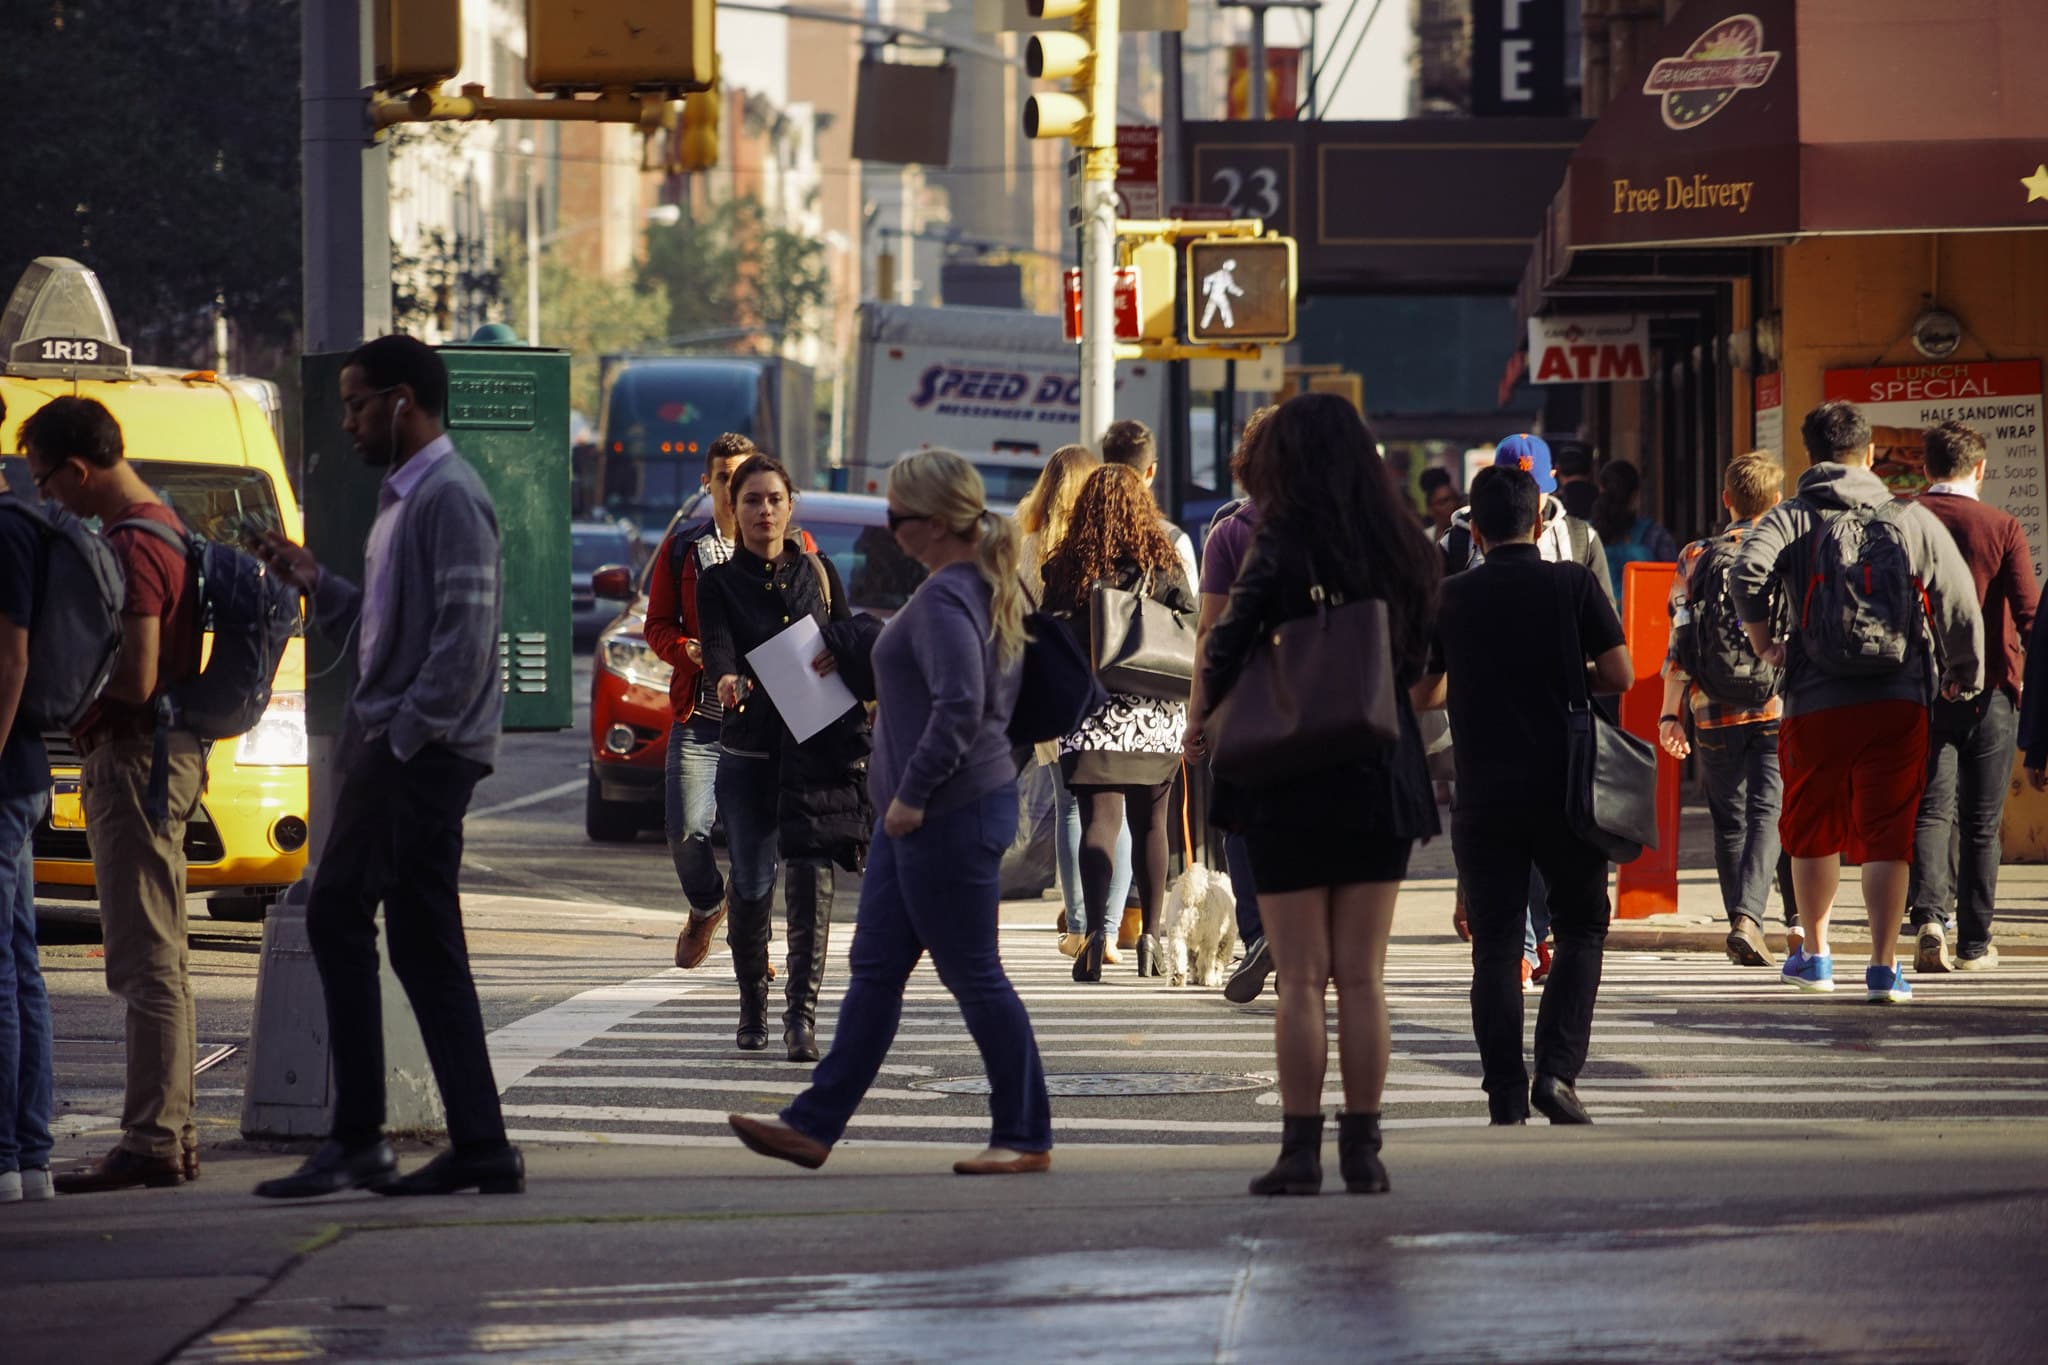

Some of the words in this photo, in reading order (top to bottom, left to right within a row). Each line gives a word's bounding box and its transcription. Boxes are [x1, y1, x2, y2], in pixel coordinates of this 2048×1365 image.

[1211, 168, 1279, 219] 23
[1613, 178, 1660, 214] Free
[1665, 173, 1754, 214] Delivery
[41, 340, 98, 361] 1R13
[1536, 344, 1645, 381] ATM
[1896, 364, 1969, 380] LUNCH
[908, 363, 1029, 408] SPEED
[1869, 376, 1998, 401] SPECIAL
[936, 402, 1035, 421] MESSENGER
[1921, 408, 1954, 422] HALF
[1958, 404, 2035, 421] SANDWICH
[1995, 424, 2036, 440] WRAP
[2006, 445, 2037, 458] WITH
[2004, 465, 2038, 481] Soup
[2008, 484, 2039, 498] AND
